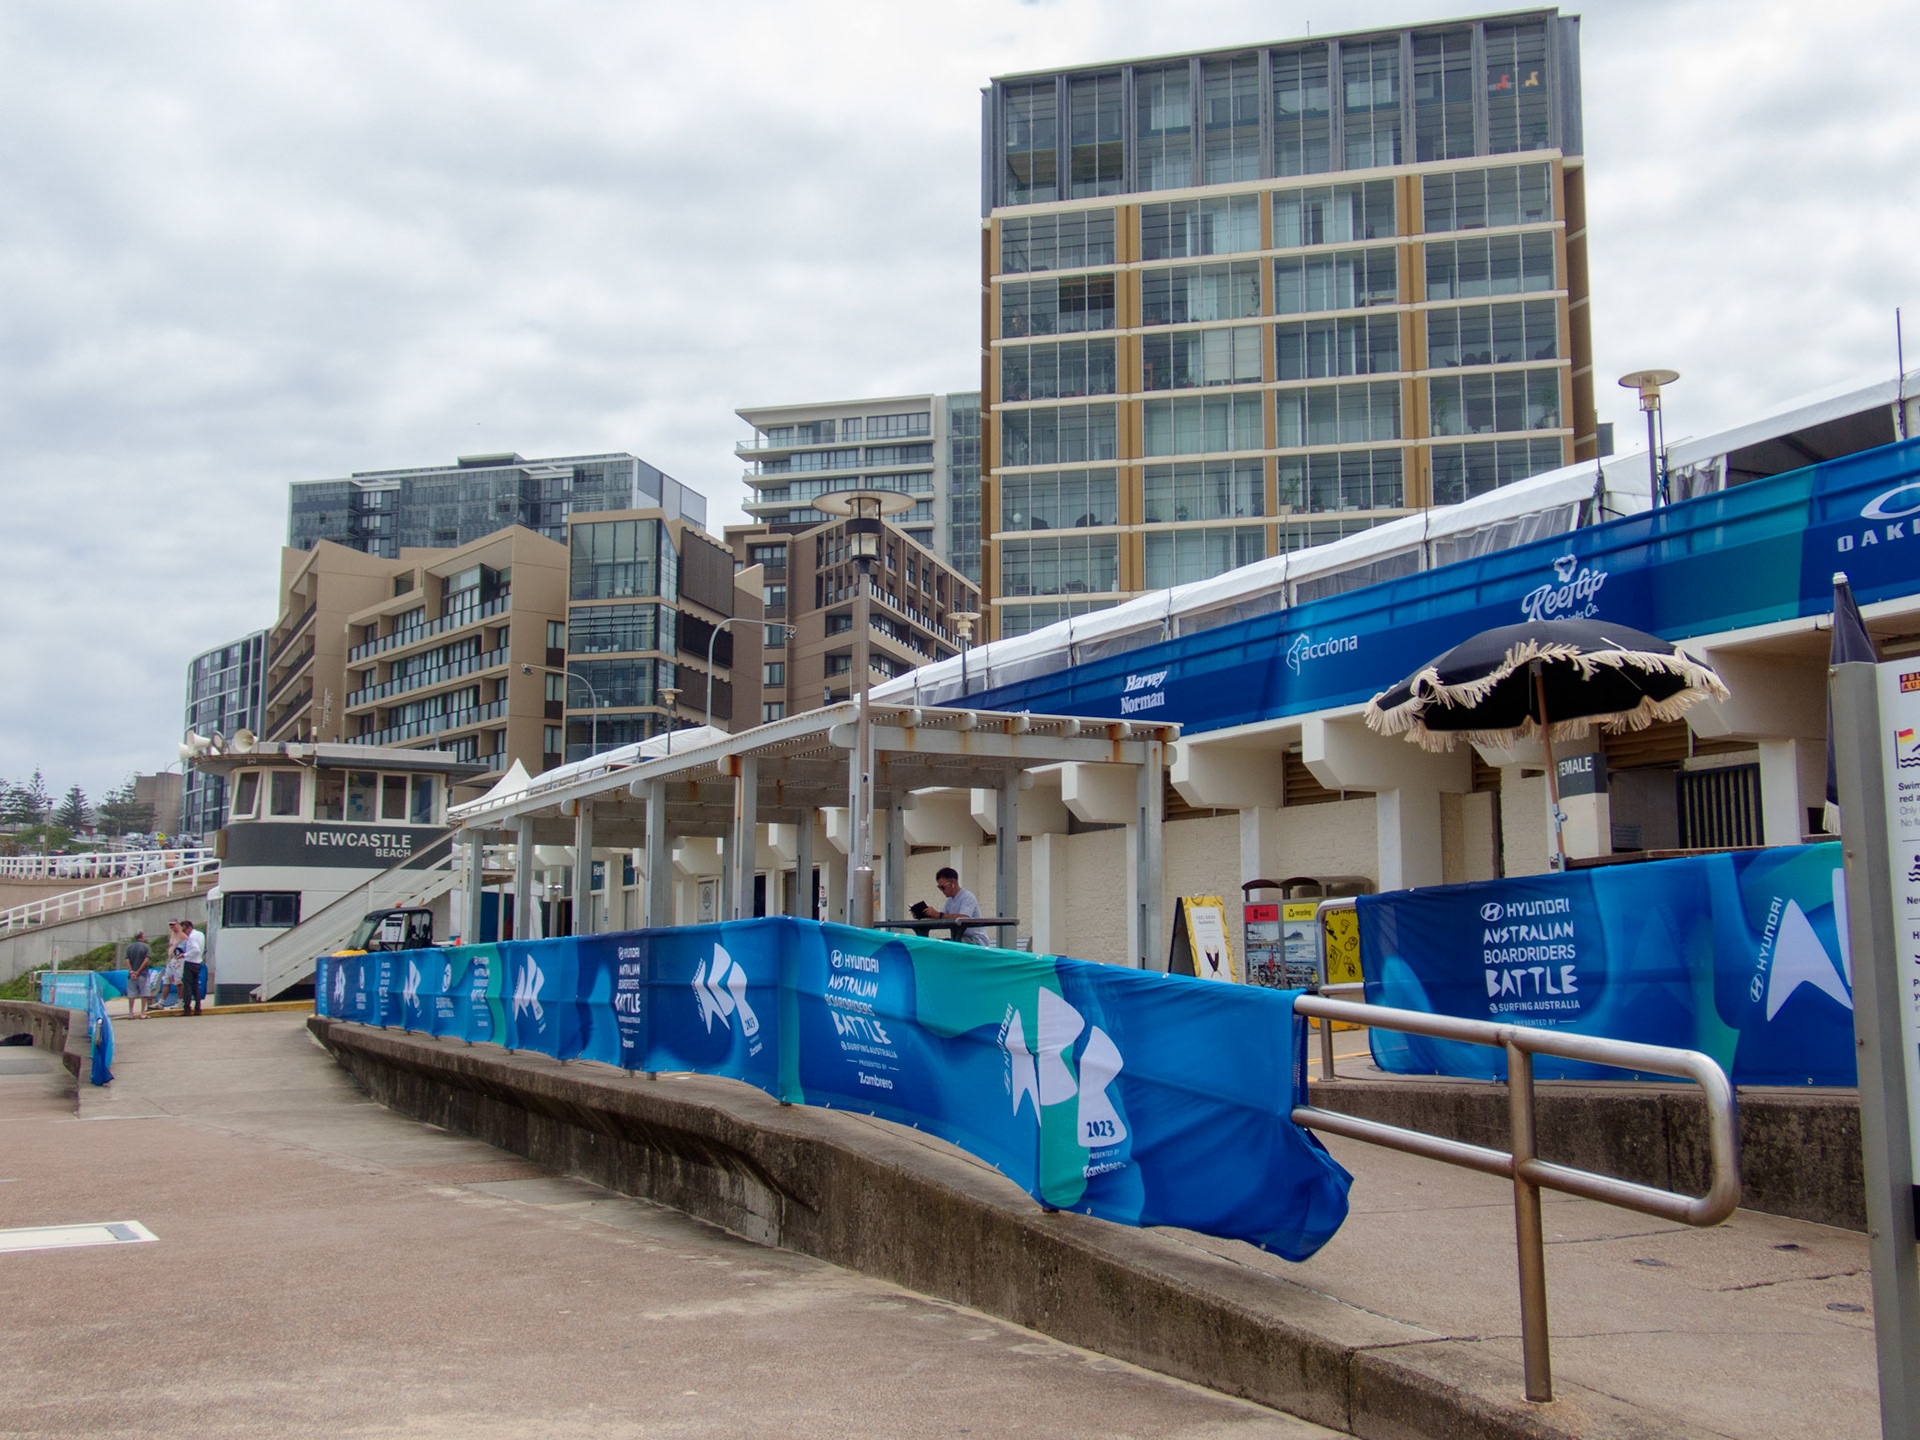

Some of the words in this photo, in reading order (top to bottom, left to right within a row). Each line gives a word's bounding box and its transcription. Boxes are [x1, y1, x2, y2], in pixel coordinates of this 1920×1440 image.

[1123, 670, 1168, 692] Harvey
[1120, 690, 1165, 715] Norman
[1558, 756, 1593, 777] FEMALE
[1899, 793, 1914, 803] red
[305, 831, 412, 849] NEWCASTLE
[375, 848, 411, 858] BEACH
[1507, 898, 1570, 917] HYUNDAI
[1483, 920, 1574, 945] AUSTRALIAN
[1757, 896, 1783, 971] HYUNDAI
[845, 953, 879, 973] HYUNDAI
[1484, 944, 1576, 964] BOARDRIDERS
[828, 974, 878, 999] AUSTRALIAN
[1485, 964, 1579, 998] BATTLE
[1498, 1001, 1533, 1012] SURFING
[1534, 1000, 1581, 1011] AUSTRALIA
[830, 1010, 892, 1045] BATTLE
[1086, 1119, 1116, 1138] 2023
